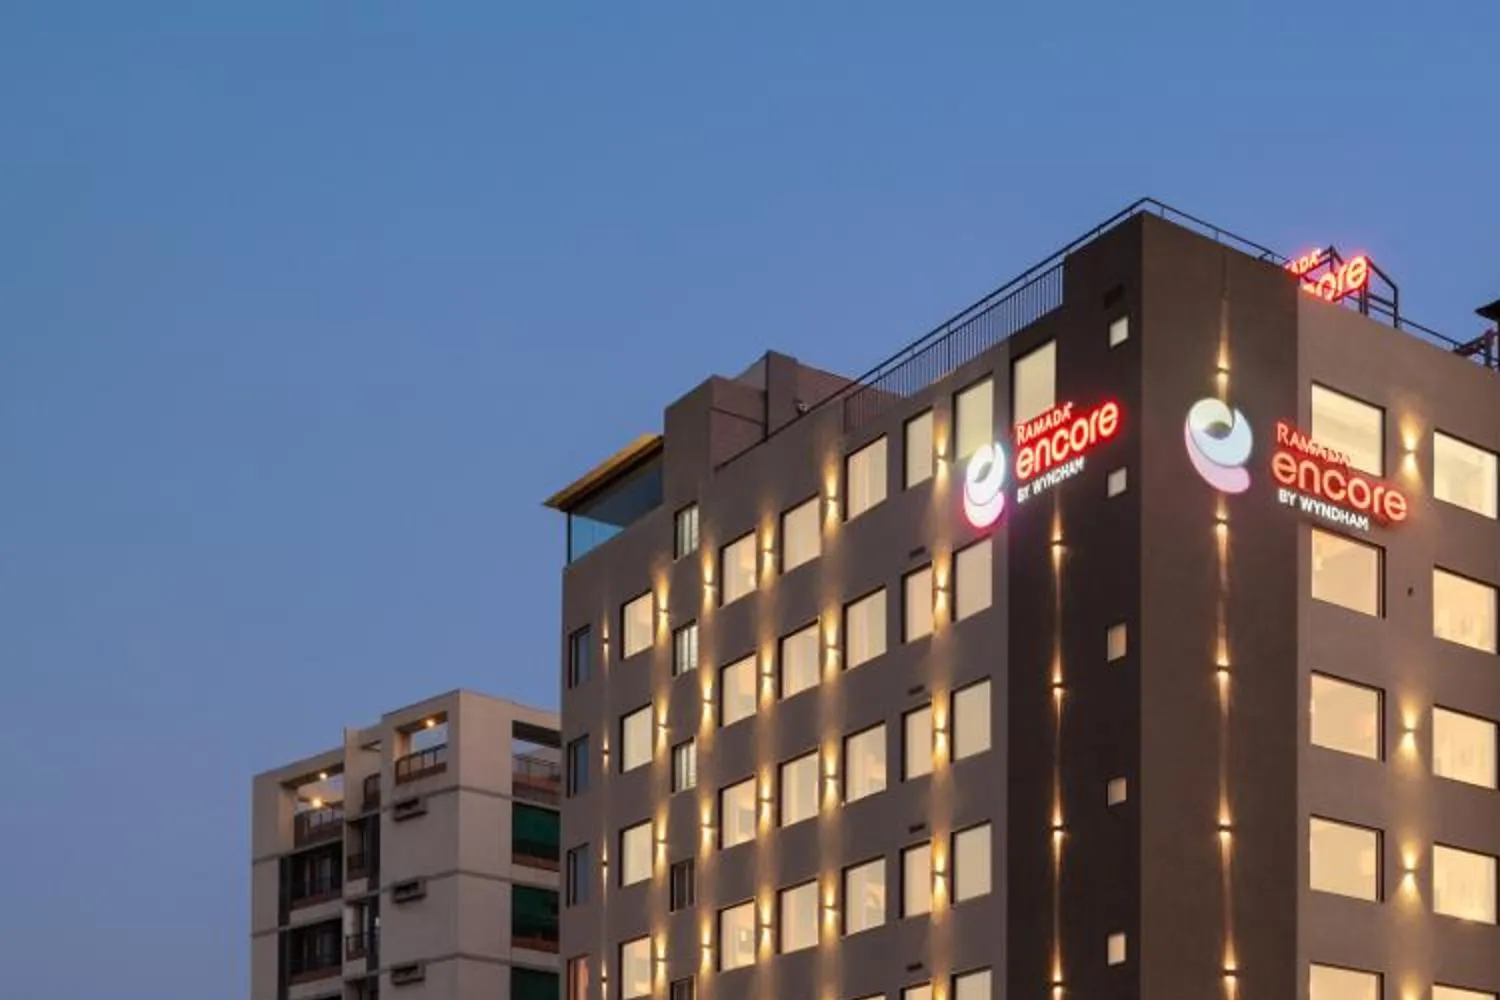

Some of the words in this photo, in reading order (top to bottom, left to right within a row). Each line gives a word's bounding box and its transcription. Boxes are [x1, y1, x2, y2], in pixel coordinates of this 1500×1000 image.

[1016, 401, 1073, 445] RAMADA
[1016, 402, 1119, 479] encore
[1017, 485, 1030, 503] BY
[1032, 456, 1085, 495] WYNDHAM
[1272, 451, 1407, 521] encore
[1278, 488, 1297, 507] BY
[1300, 496, 1369, 531] WYNDHAM
